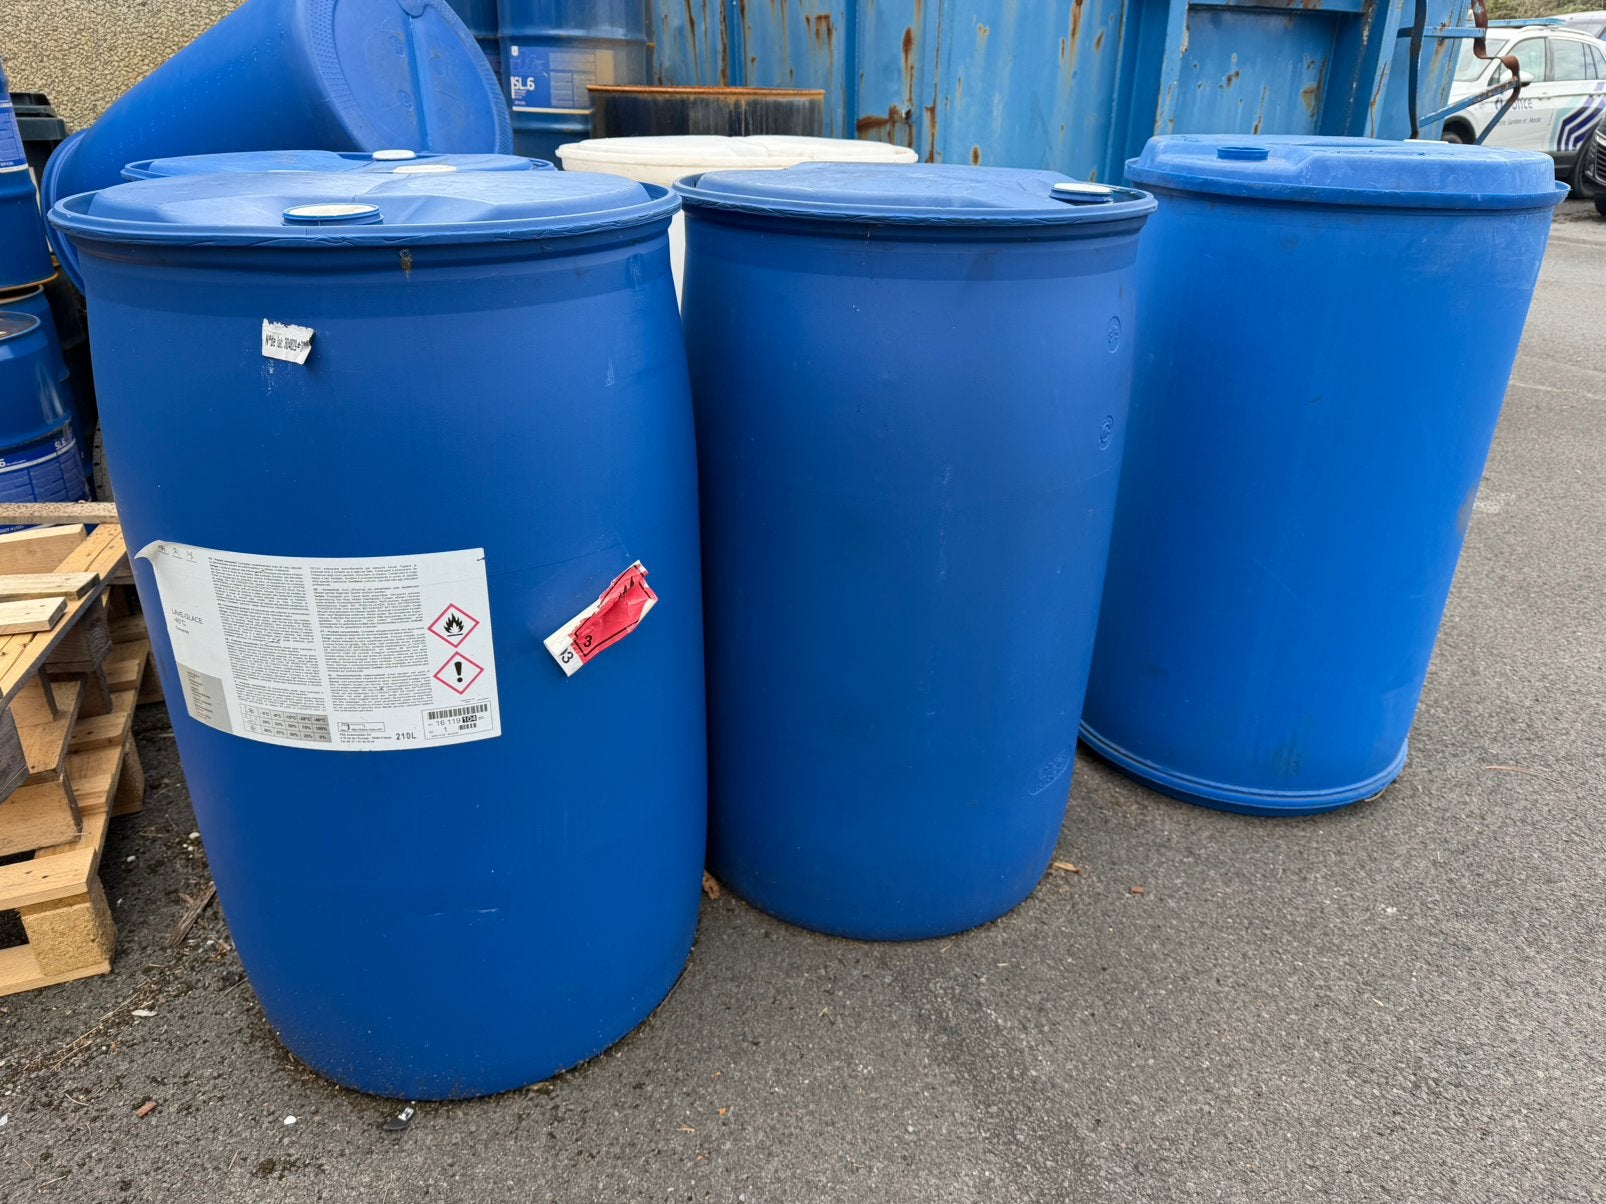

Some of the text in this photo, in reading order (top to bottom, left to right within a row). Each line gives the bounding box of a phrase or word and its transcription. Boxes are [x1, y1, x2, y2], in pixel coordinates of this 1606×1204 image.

[583, 635, 593, 648] 3
[447, 717, 461, 725] 119
[395, 731, 417, 741] 210L
